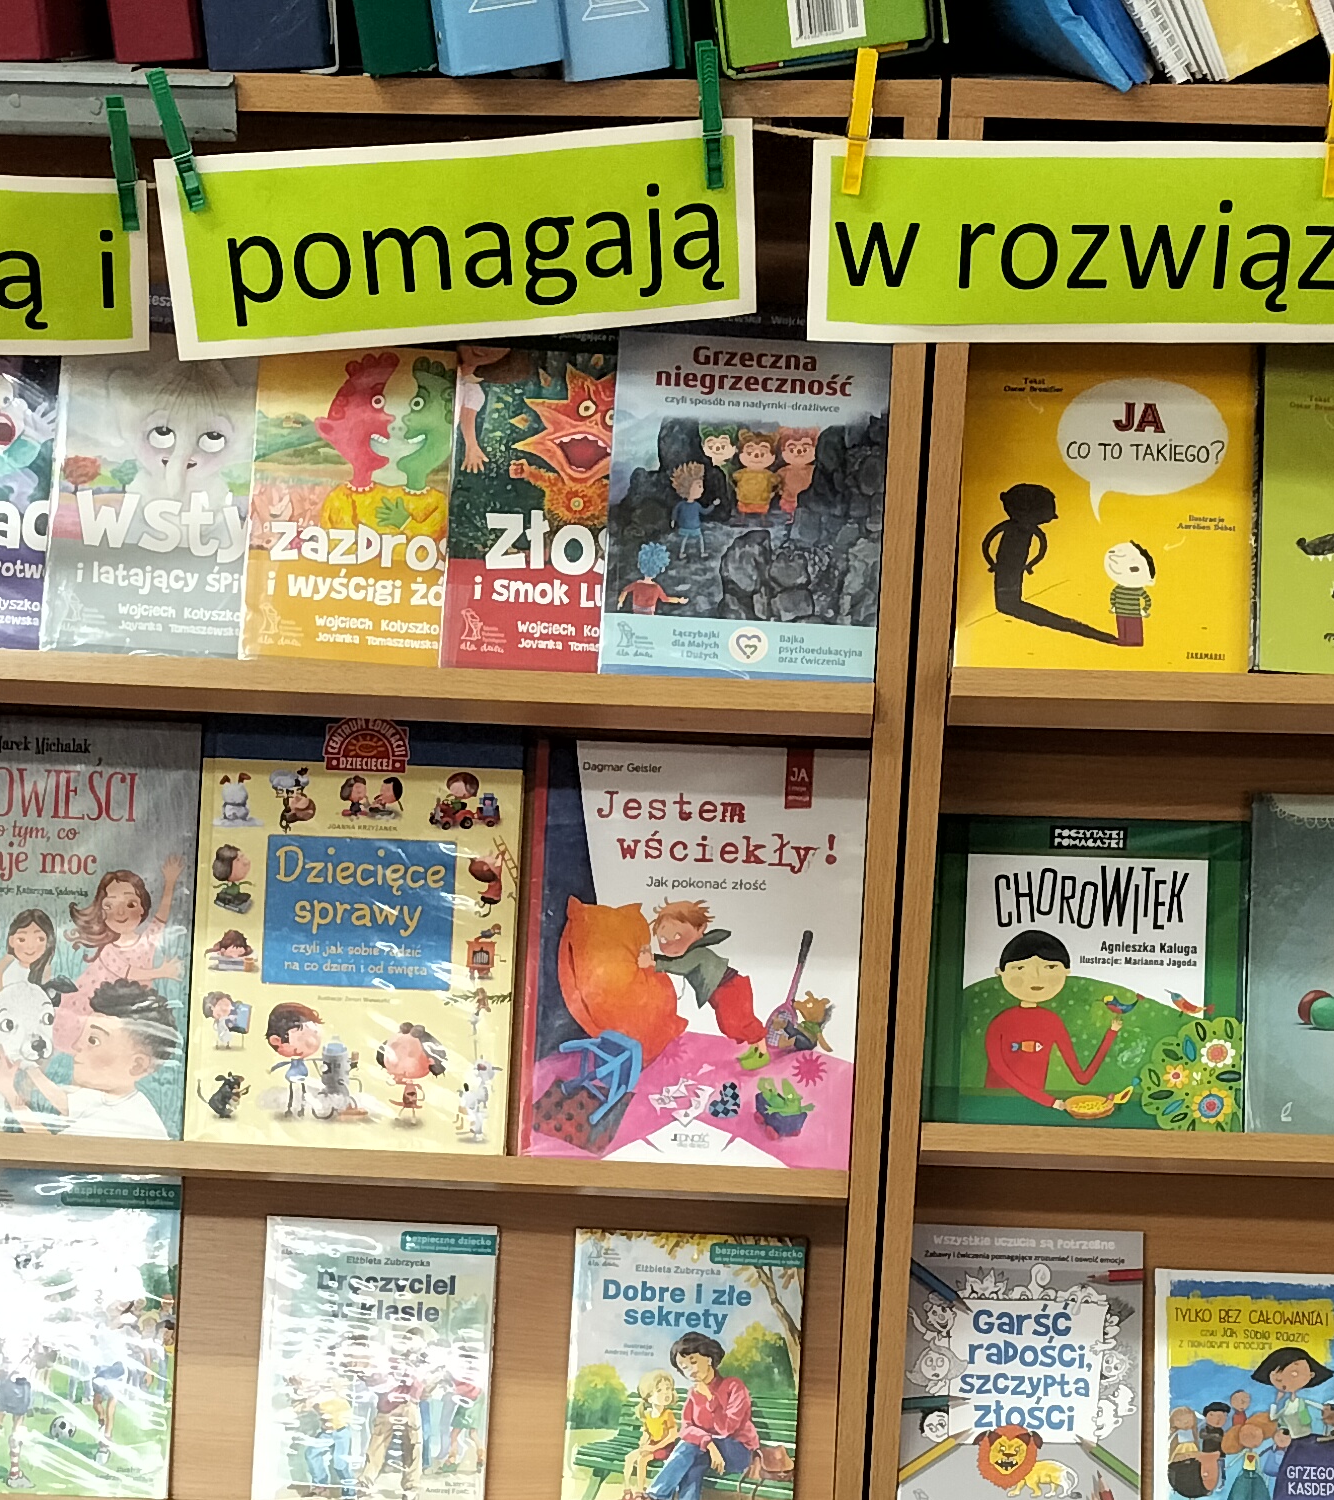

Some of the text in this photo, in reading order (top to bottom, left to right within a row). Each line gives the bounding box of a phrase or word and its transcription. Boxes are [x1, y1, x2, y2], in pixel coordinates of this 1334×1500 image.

[228, 182, 727, 327] pomagają
[834, 220, 923, 288] w
[99, 227, 116, 311] i
[693, 346, 818, 372] Grzeczna
[656, 366, 855, 397] niegrzeczność
[689, 397, 725, 408] sposób
[1130, 438, 1225, 463] TAKIEGO?
[35, 737, 92, 755] Michalak
[582, 761, 624, 775] Dagmar
[596, 790, 747, 824] Jestem
[38, 851, 98, 876] moc
[616, 833, 839, 875] wściekły!
[275, 846, 447, 896] Dziecięce
[646, 876, 767, 893] Jak pokonać złość
[994, 864, 1190, 935] CHOROWITEK
[294, 898, 422, 936] sprawy
[1100, 940, 1155, 956] Agnieszka
[602, 1278, 752, 1307] Dobre złe
[623, 1305, 729, 1335] sekrety
[1218, 1308, 1242, 1326] BEZ
